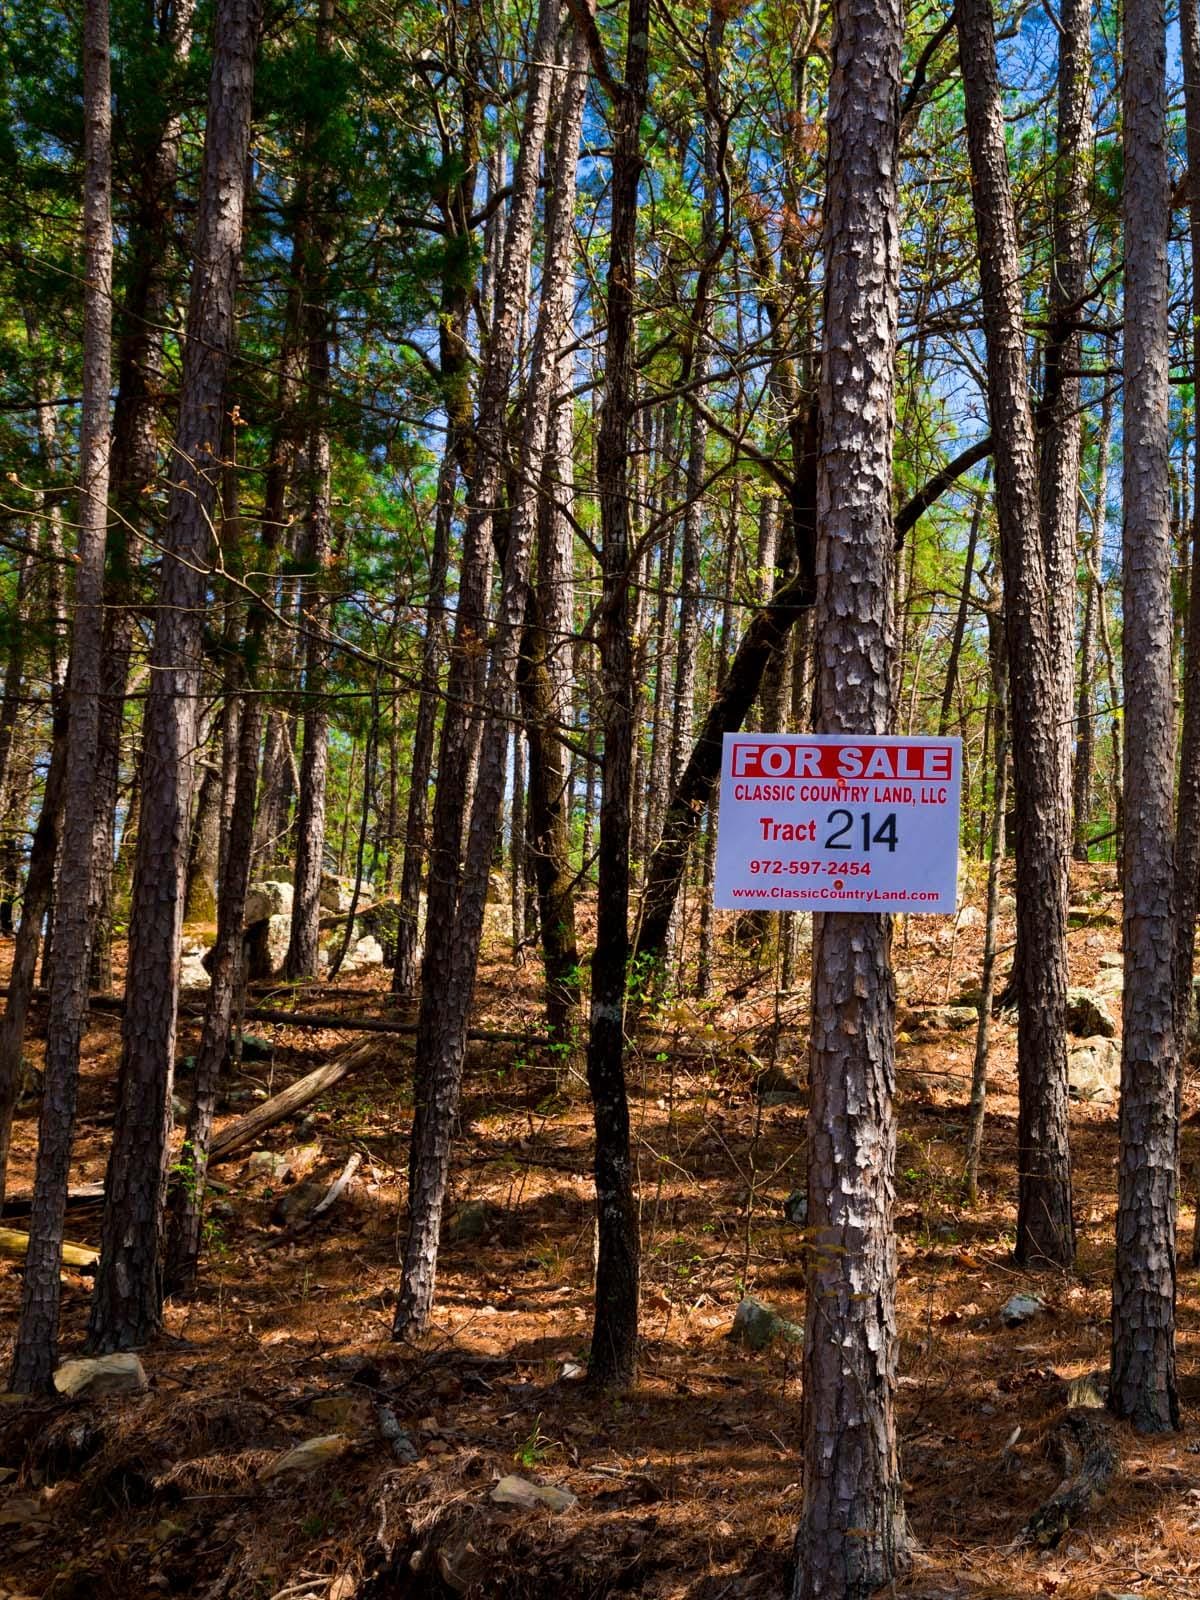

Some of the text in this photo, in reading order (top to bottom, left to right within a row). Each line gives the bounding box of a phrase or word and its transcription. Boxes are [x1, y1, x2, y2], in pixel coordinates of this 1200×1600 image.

[735, 746, 949, 779] FOR SALE
[735, 785, 947, 807] CLASSIC COUNTRY LAND, LLC
[760, 809, 898, 852] Tract 214
[750, 861, 871, 875] 972-597-2454
[732, 887, 939, 902] www.ClassicCountryLand.com
